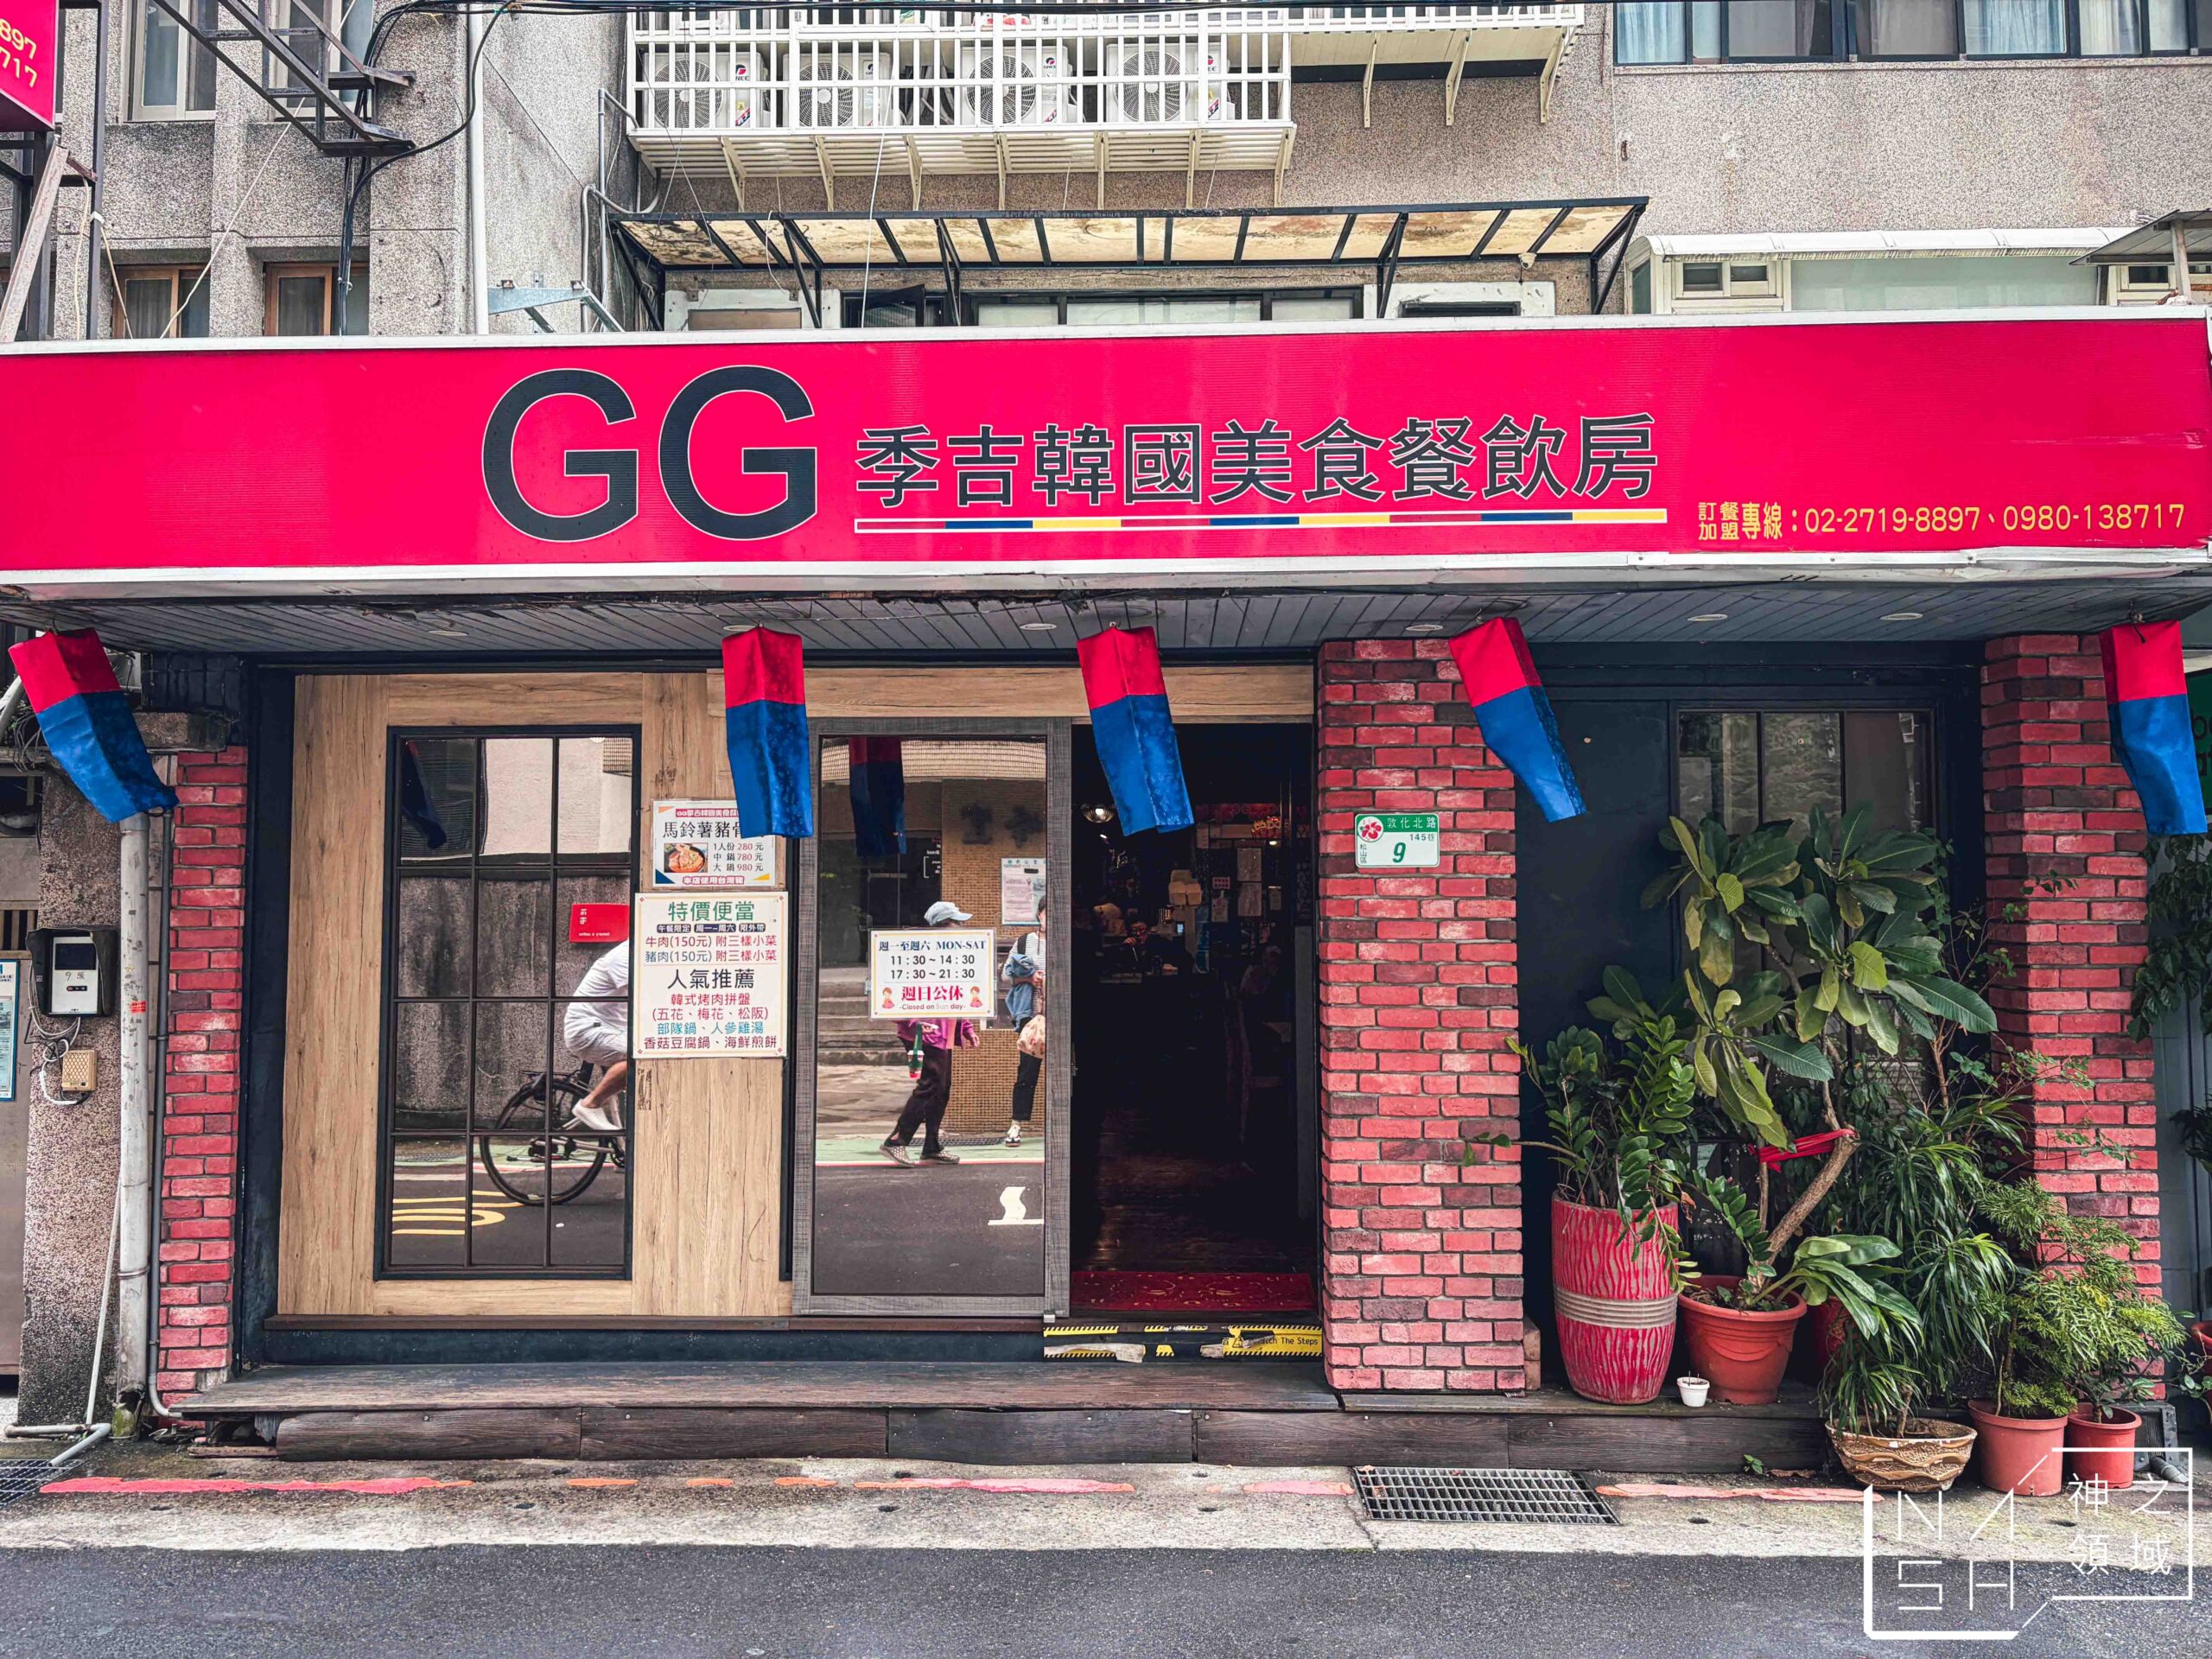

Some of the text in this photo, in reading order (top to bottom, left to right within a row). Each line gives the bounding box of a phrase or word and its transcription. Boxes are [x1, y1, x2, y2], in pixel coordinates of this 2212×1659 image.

[481, 365, 1658, 542] GG 季吉韓國美食餐飲房
[1698, 502, 1739, 520] 訂餐
[1698, 522, 1739, 540] 加盟
[663, 821, 741, 838] 馬鈴薯豬骨
[1387, 817, 1435, 830] 敦化北路
[737, 842, 753, 851] 280
[754, 842, 764, 851] 元
[1392, 842, 1407, 863] 9
[754, 853, 764, 861] 元
[737, 863, 753, 872] 980
[754, 863, 764, 872] 元
[668, 901, 754, 922] 特價便當
[645, 935, 777, 948] 牛肉(150元) 附三樣小菜
[879, 940, 986, 951] 週一至週六 MON-SAT
[645, 950, 777, 963] 豬肉(150元) 附三樣小菜
[667, 969, 754, 989] 人氣推薦
[671, 993, 751, 1006] 韓式烤肉拼盤
[901, 986, 964, 1001] 週日公休
[1297, 1338, 1319, 1346] Steps
